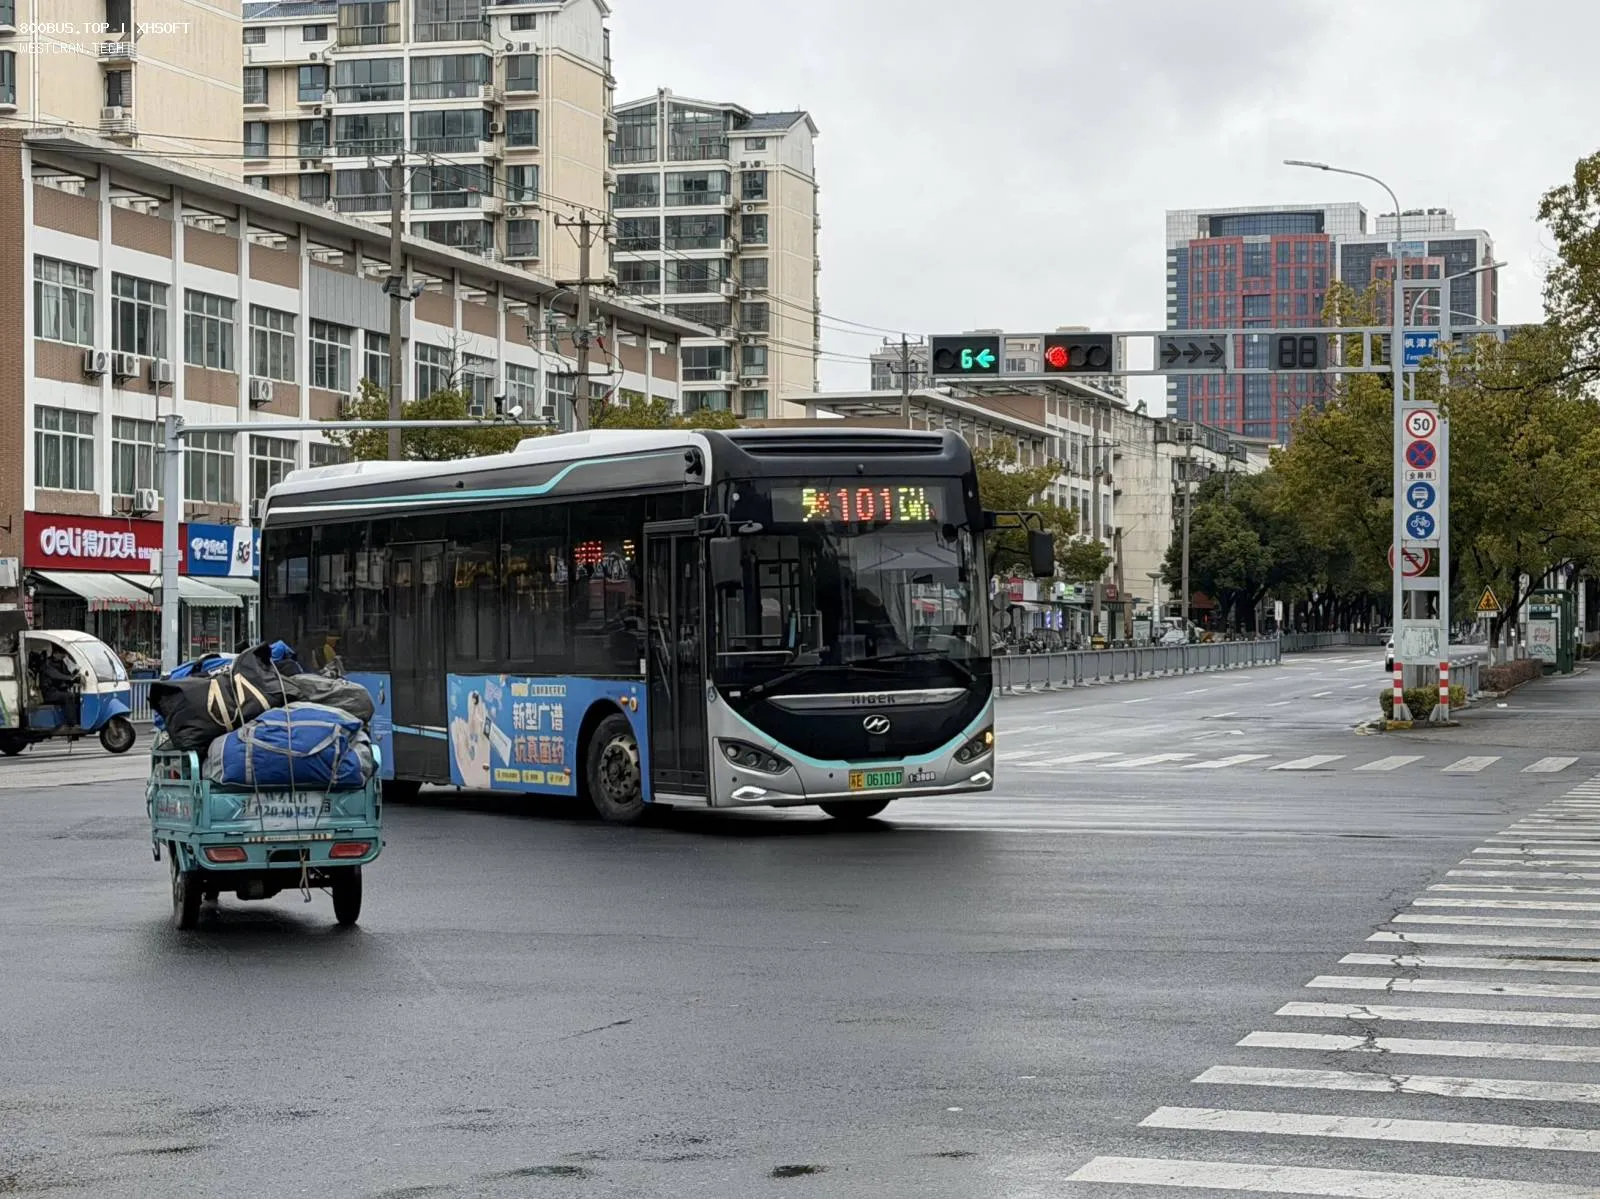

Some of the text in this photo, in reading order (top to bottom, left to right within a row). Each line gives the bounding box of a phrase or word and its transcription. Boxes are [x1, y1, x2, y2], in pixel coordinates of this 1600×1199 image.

[961, 349, 973, 368] 6
[1413, 418, 1430, 431] 50
[837, 488, 891, 521] 101
[40, 526, 82, 556] deli
[82, 529, 136, 558] 得力文具
[851, 694, 896, 704] HIGER
[512, 702, 564, 731] 新型广谱
